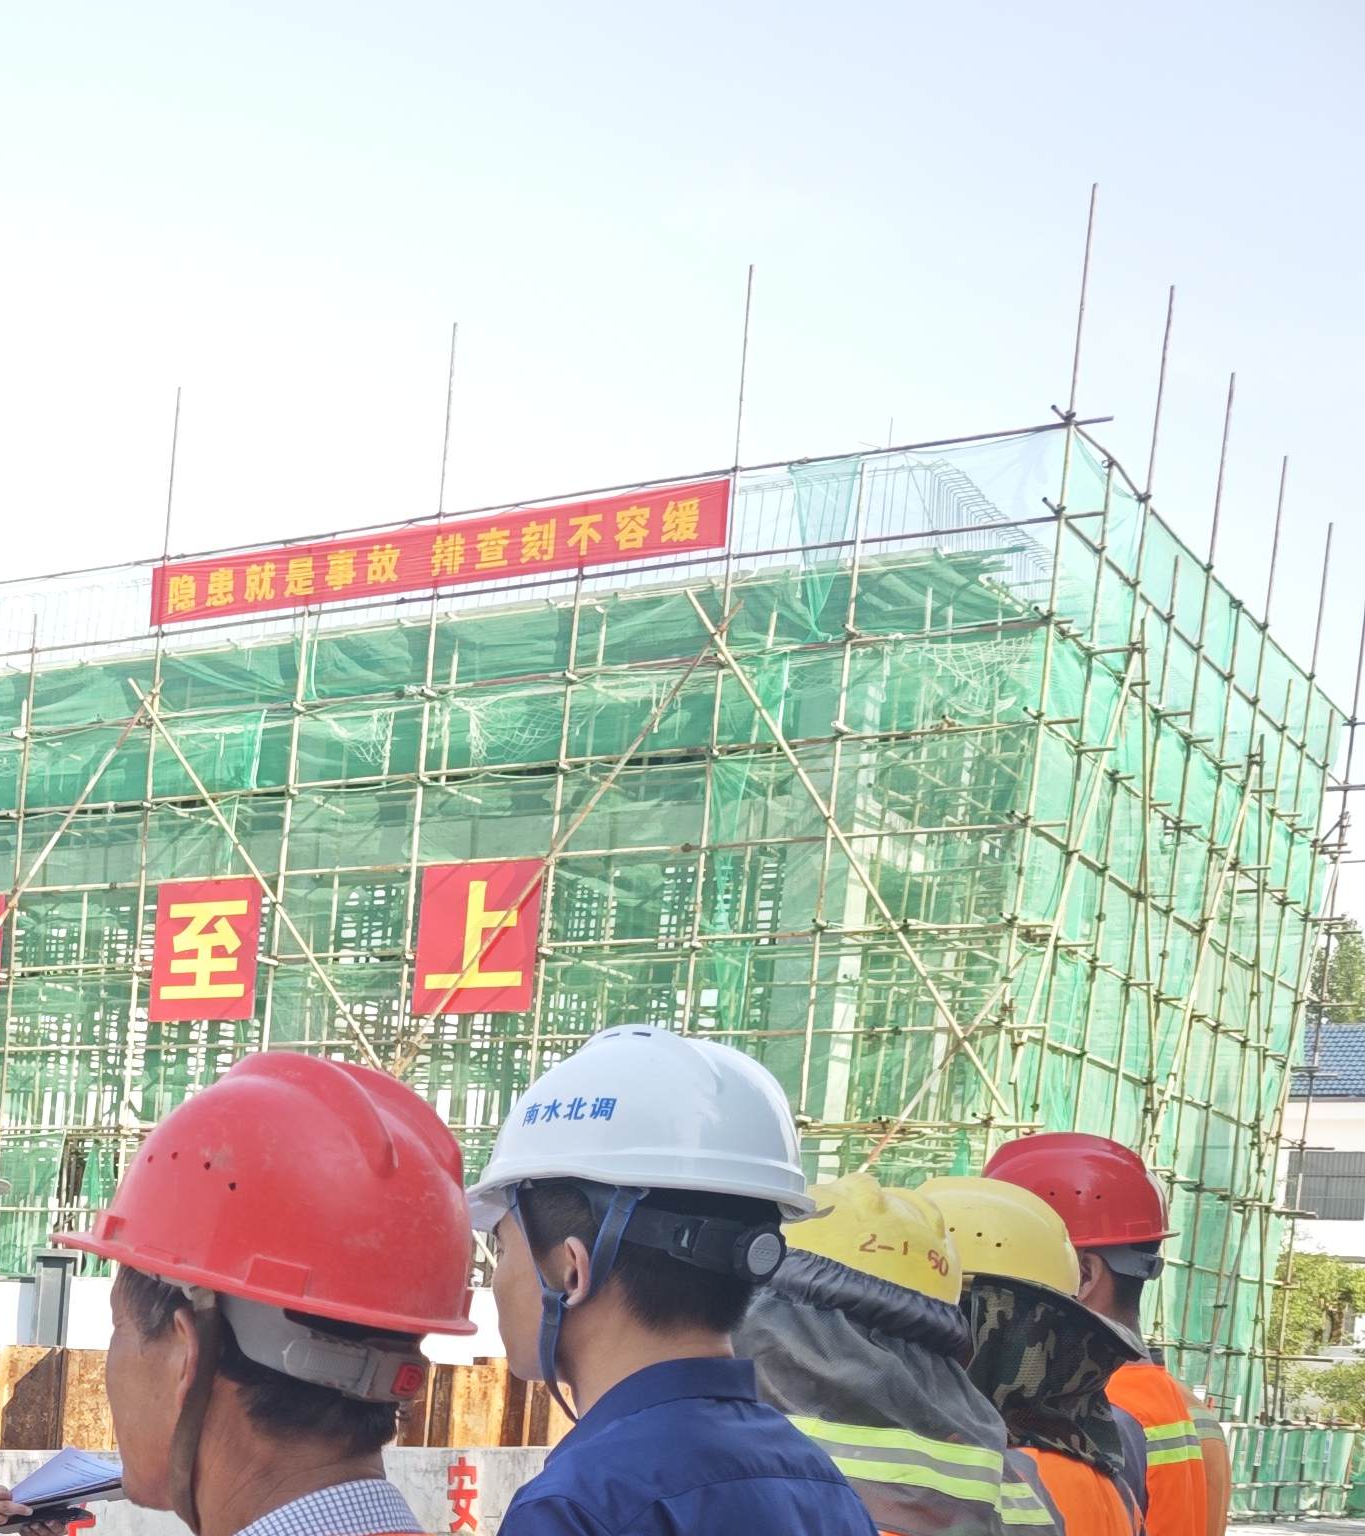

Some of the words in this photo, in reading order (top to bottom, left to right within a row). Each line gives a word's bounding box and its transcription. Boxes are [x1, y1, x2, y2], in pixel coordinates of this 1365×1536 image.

[166, 543, 402, 614] 隐患就是事故
[431, 498, 701, 578] 排查刻不容缓
[522, 1096, 618, 1128] 南水北调
[447, 1456, 478, 1533] 安
